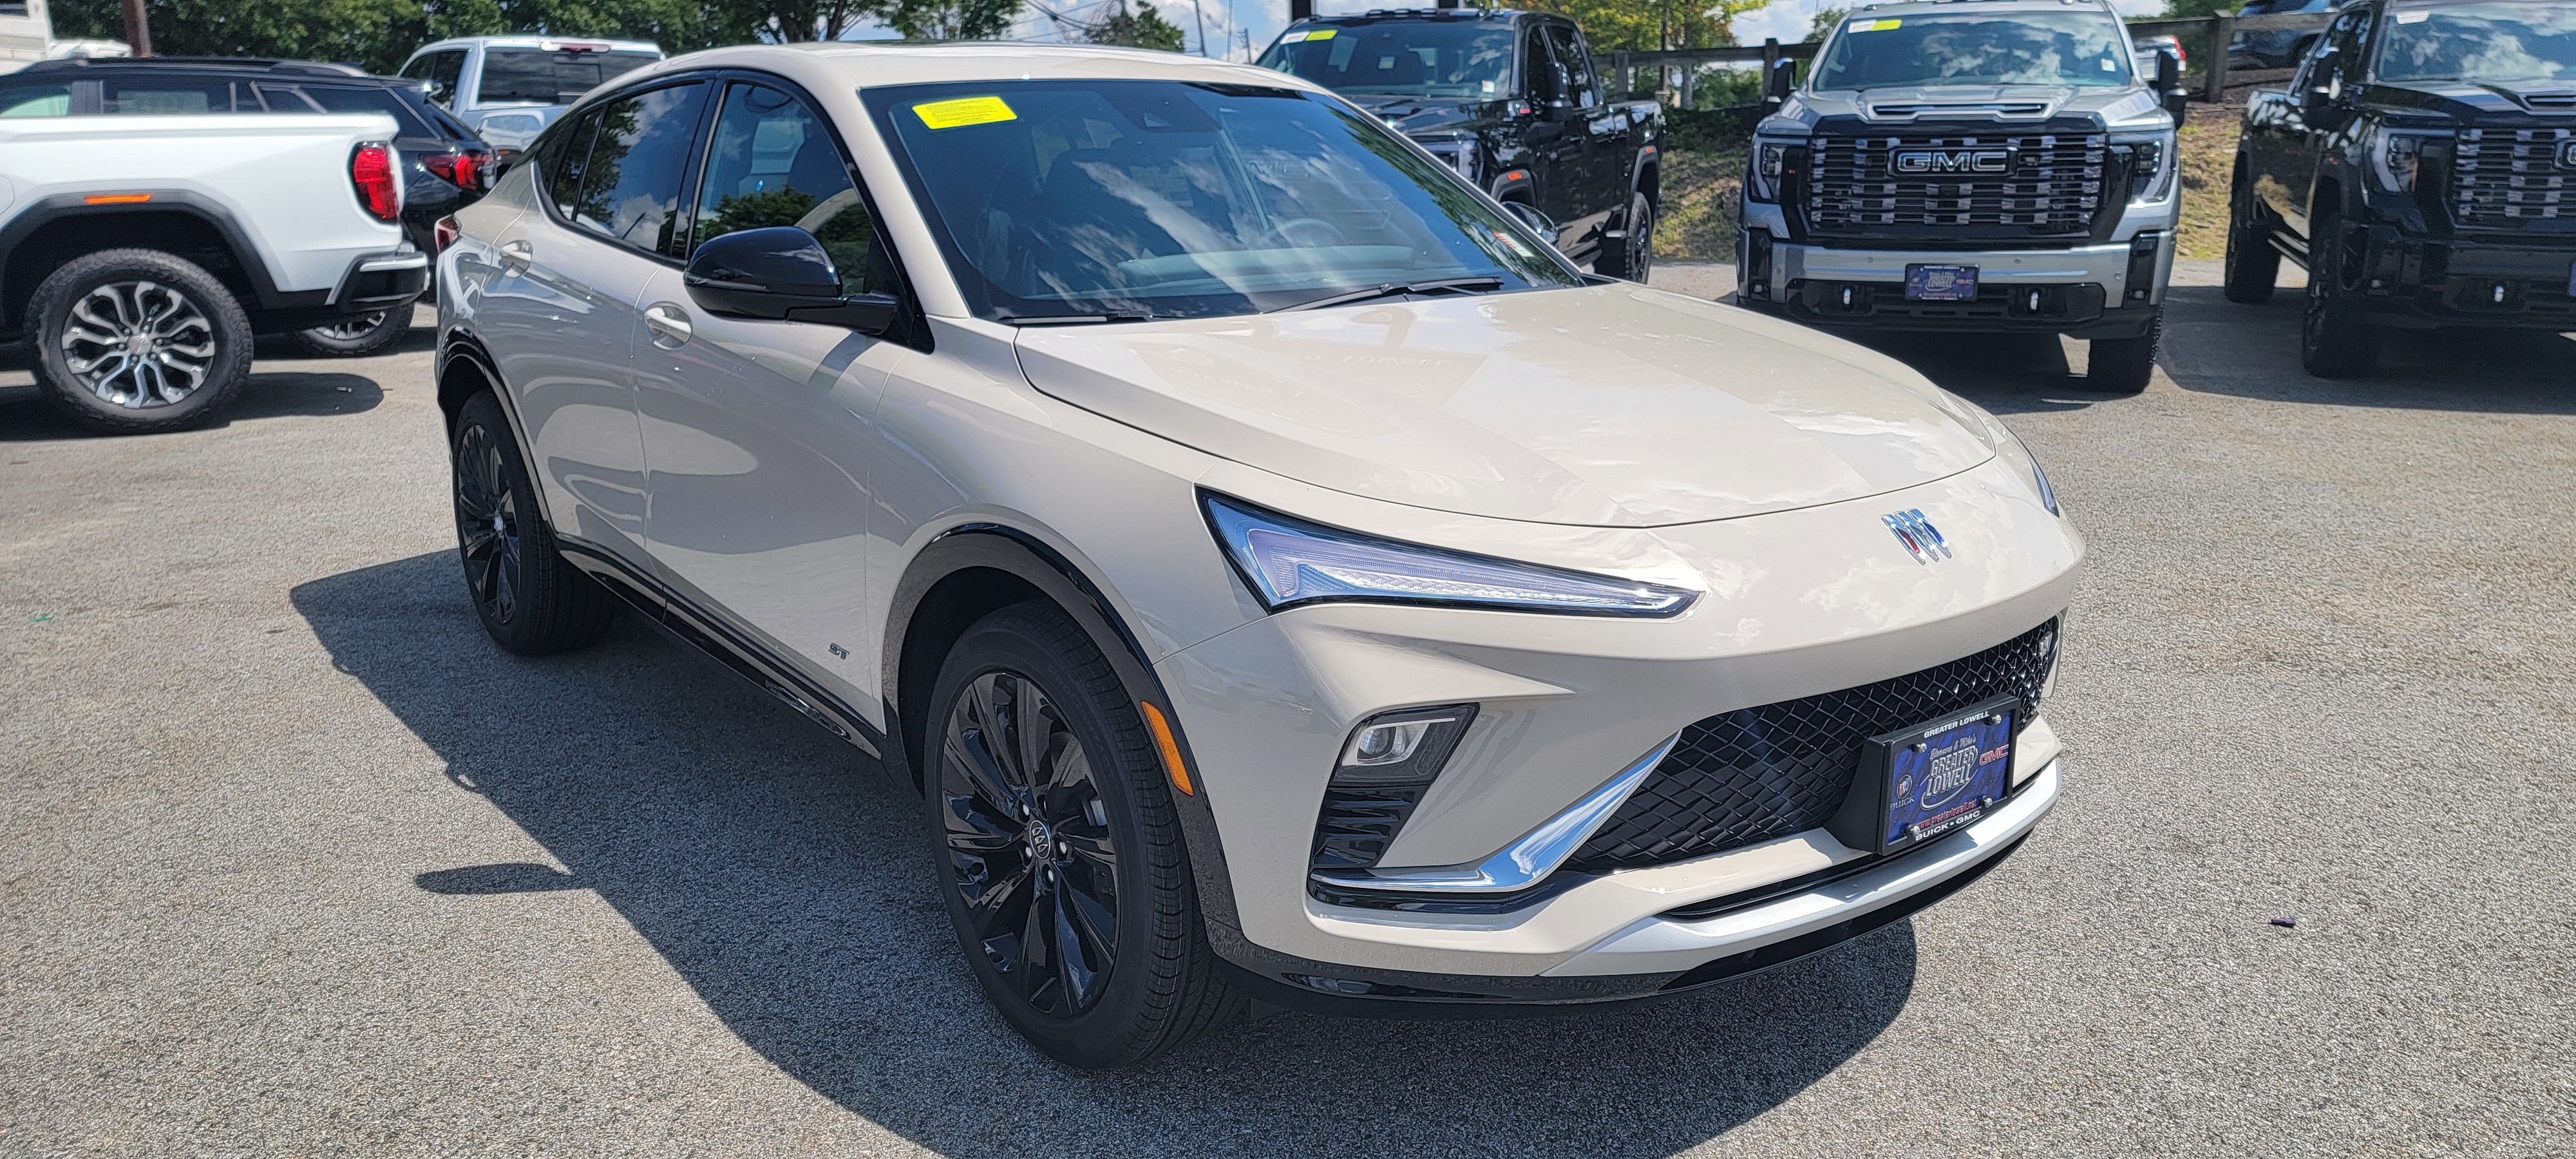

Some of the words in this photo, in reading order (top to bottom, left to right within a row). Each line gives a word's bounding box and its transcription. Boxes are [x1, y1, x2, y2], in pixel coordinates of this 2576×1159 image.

[1897, 151, 2007, 172] GMC
[828, 643, 850, 660] ST
[1924, 721, 1958, 739] GREATER
[1960, 710, 1990, 726] LOWELL
[1930, 745, 1976, 777] GREATER
[1979, 744, 2009, 766] GMC
[1924, 764, 1971, 800] LOWELL
[1890, 796, 1915, 811] BUICK
[1915, 822, 1949, 842] BUICK
[1956, 810, 1981, 824] GMC
